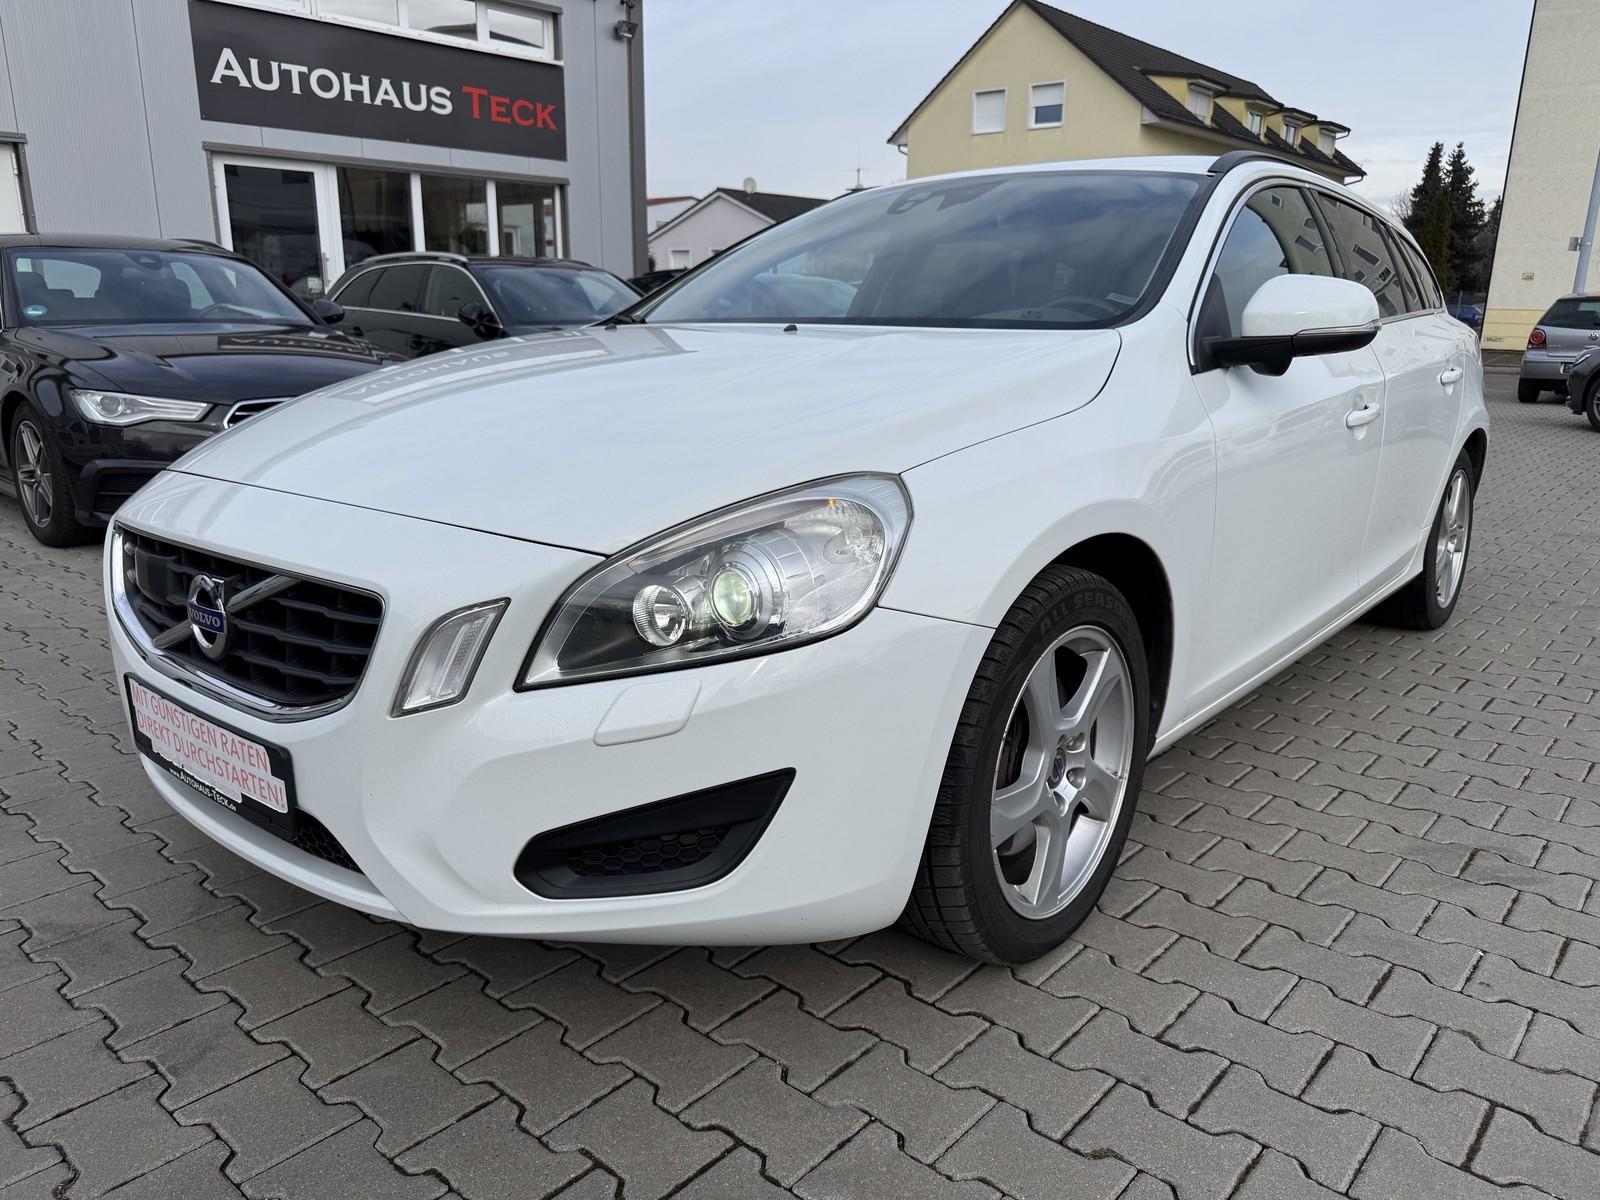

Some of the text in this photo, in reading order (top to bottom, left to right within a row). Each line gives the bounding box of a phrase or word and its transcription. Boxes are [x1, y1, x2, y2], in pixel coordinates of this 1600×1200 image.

[210, 47, 558, 130] AUTOHAUS TECK
[188, 607, 221, 628] VOLVO
[1040, 601, 1070, 636] ALL
[131, 683, 149, 710] MIT
[219, 731, 269, 773] RATEN
[136, 709, 285, 809] DIREKT DURCHSTARTEN!
